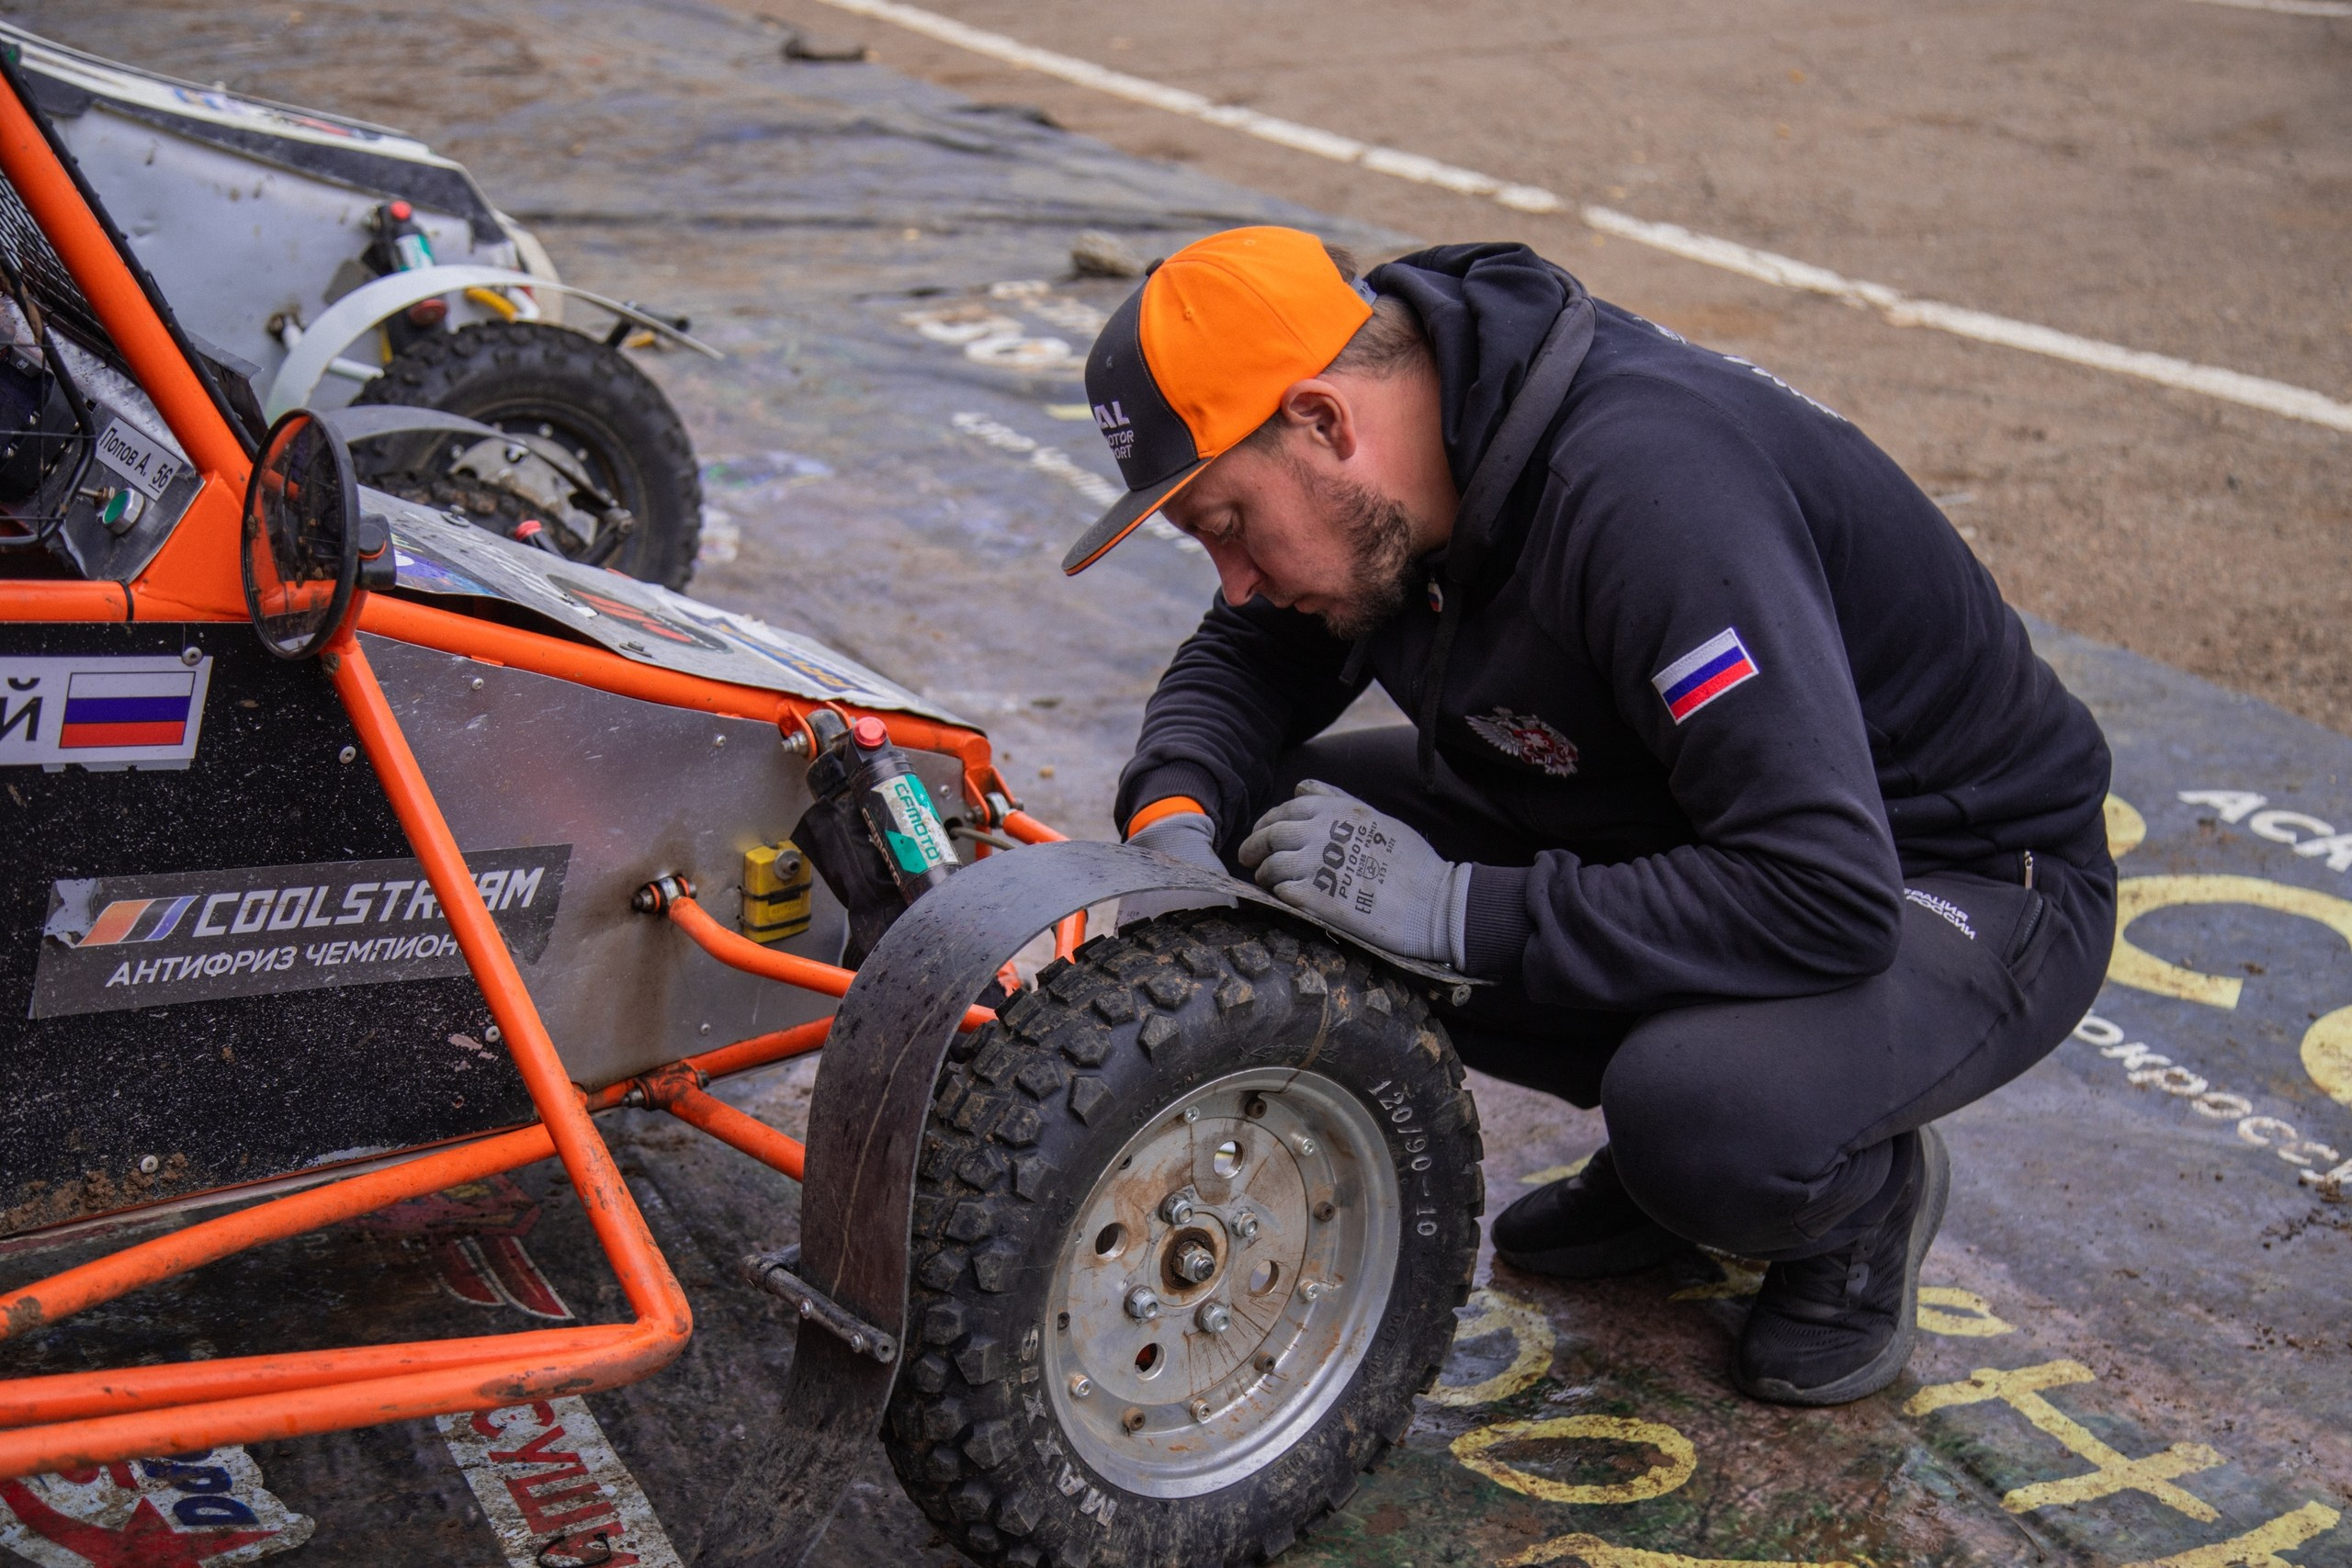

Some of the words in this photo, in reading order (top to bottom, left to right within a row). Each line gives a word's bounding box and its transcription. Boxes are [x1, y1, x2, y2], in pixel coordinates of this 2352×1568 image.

[1105, 430, 1135, 446] OTOR
[99, 426, 140, 467] Попов
[134, 452, 152, 477] А.
[152, 463, 174, 489] 56
[1113, 445, 1133, 459] ORT
[895, 783, 939, 860] CFMOTO
[1373, 832, 1387, 847] 9
[1385, 837, 1397, 854] SIZE
[1312, 819, 1355, 898] DOG
[1338, 825, 1367, 899] PU1001G
[1378, 862, 1389, 885] 4131
[1354, 888, 1374, 915] EAC
[105, 945, 296, 988] АНТИФРИЗ
[306, 933, 463, 967] ЧЕМПИОН
